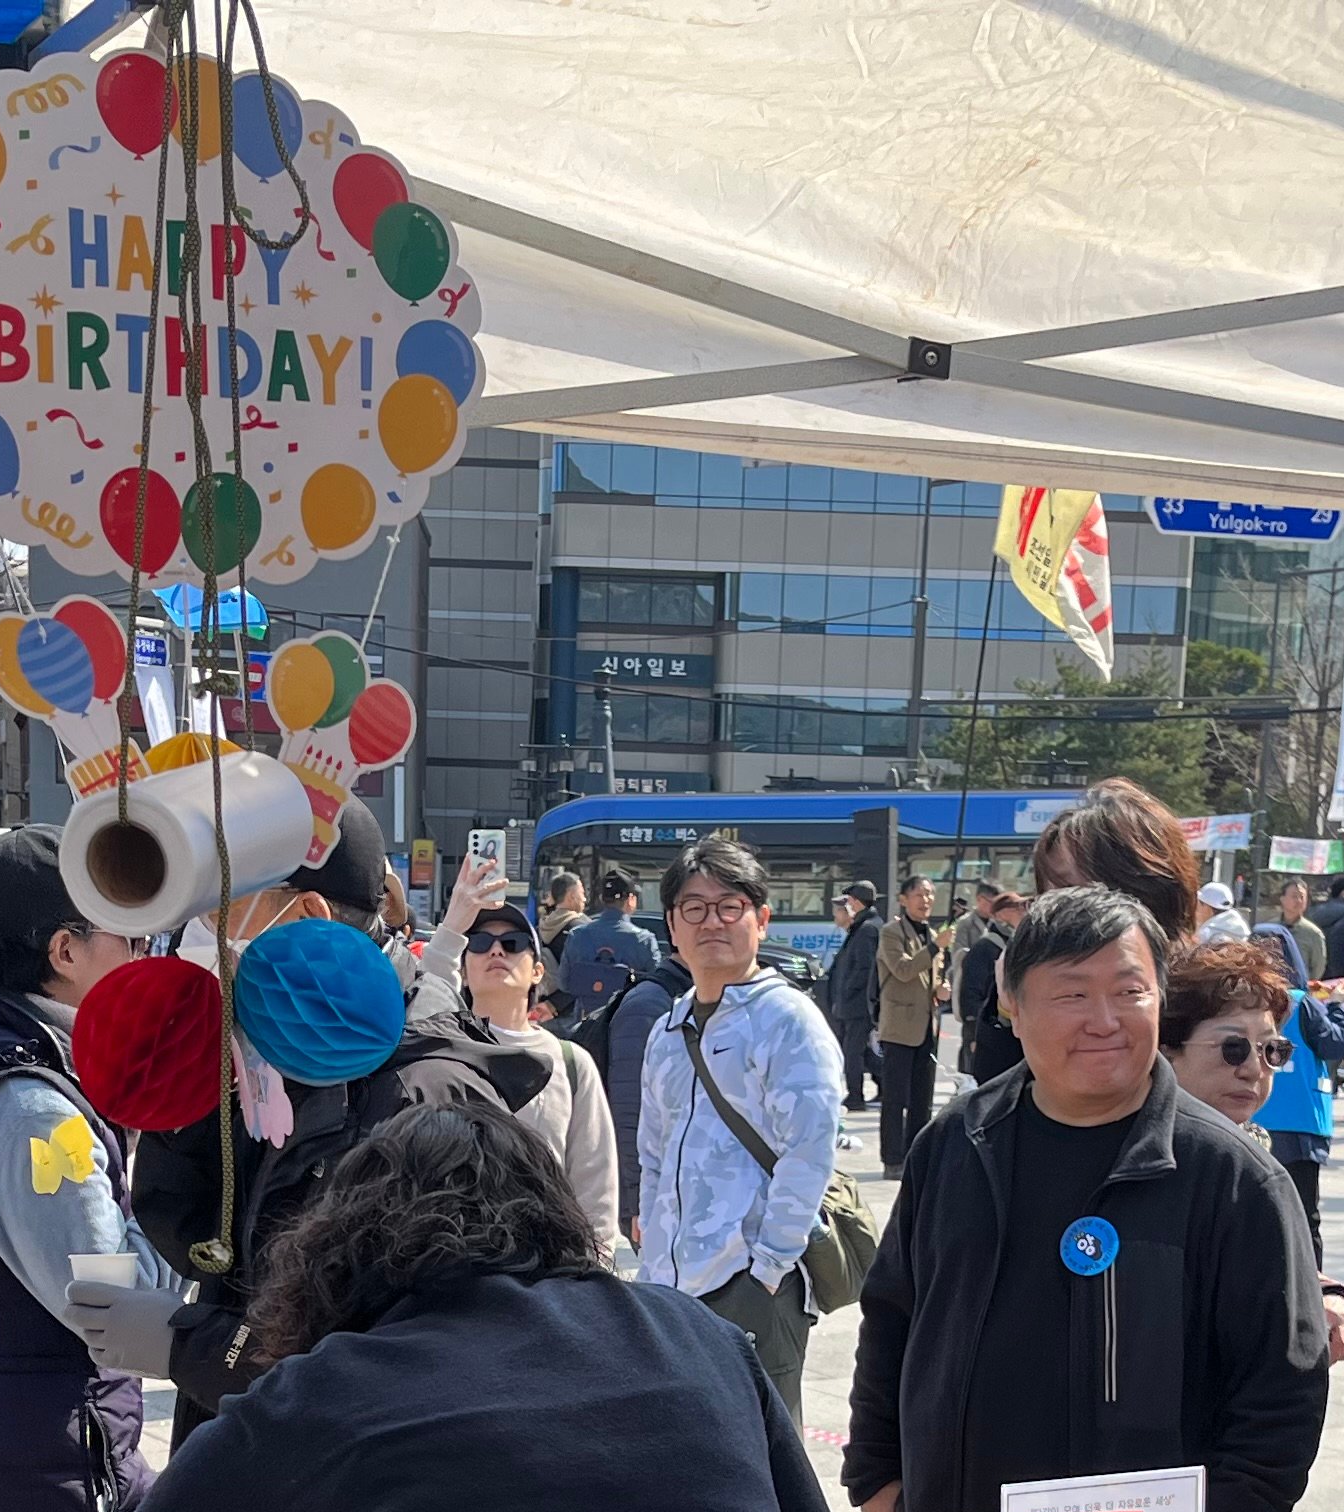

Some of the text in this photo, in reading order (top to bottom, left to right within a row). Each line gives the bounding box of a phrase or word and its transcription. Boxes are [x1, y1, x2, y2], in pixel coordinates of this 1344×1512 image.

[67, 206, 293, 306] HAPPY
[1208, 512, 1288, 534] Yulgok-ro
[602, 655, 688, 678] 신아일보
[619, 826, 653, 843] 친환경
[791, 933, 843, 950] 삼성카드
